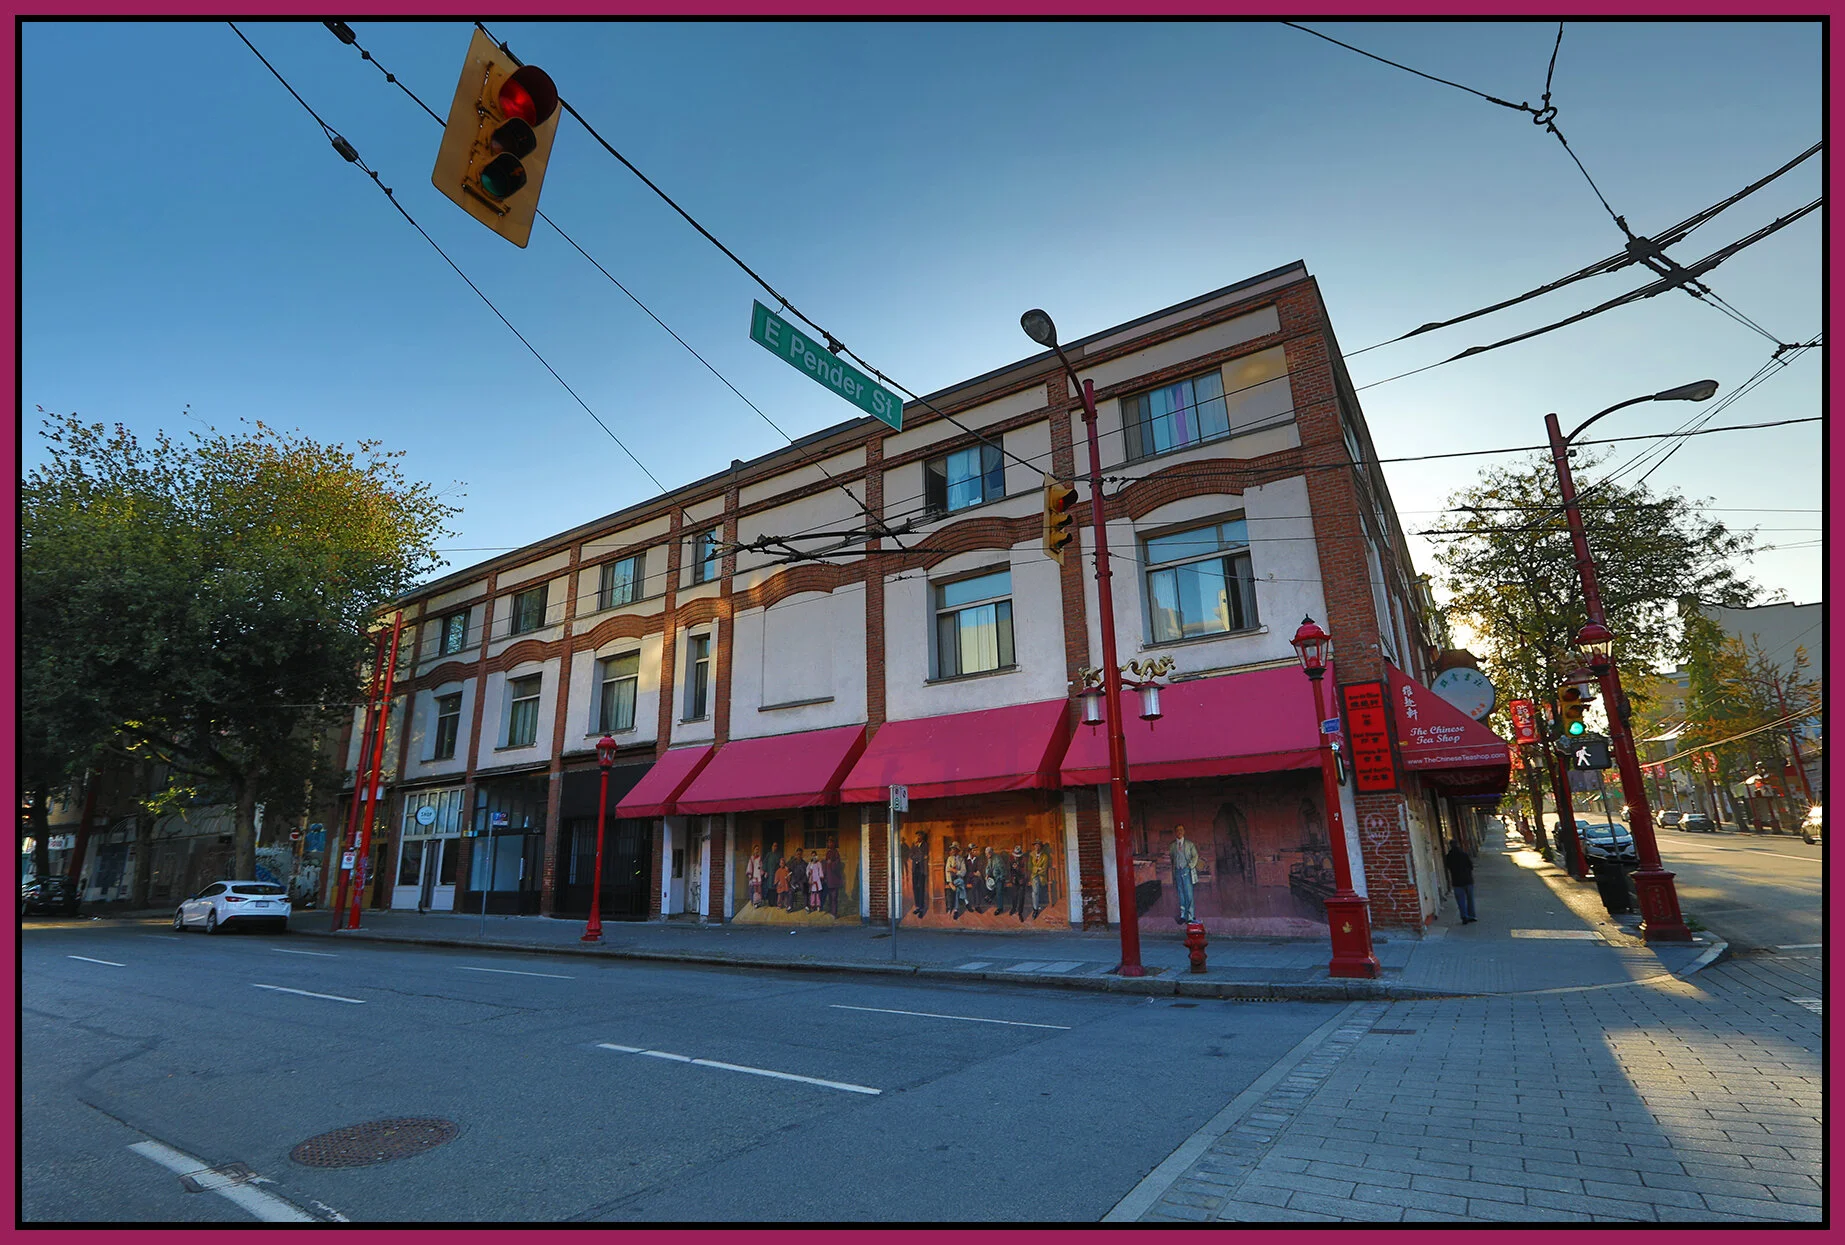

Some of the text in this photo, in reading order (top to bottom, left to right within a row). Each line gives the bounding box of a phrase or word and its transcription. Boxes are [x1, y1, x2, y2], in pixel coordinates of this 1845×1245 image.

[764, 316, 893, 419] E Pender St
[1410, 726, 1465, 736] The Chinese
[1416, 734, 1461, 745] Tea Shop
